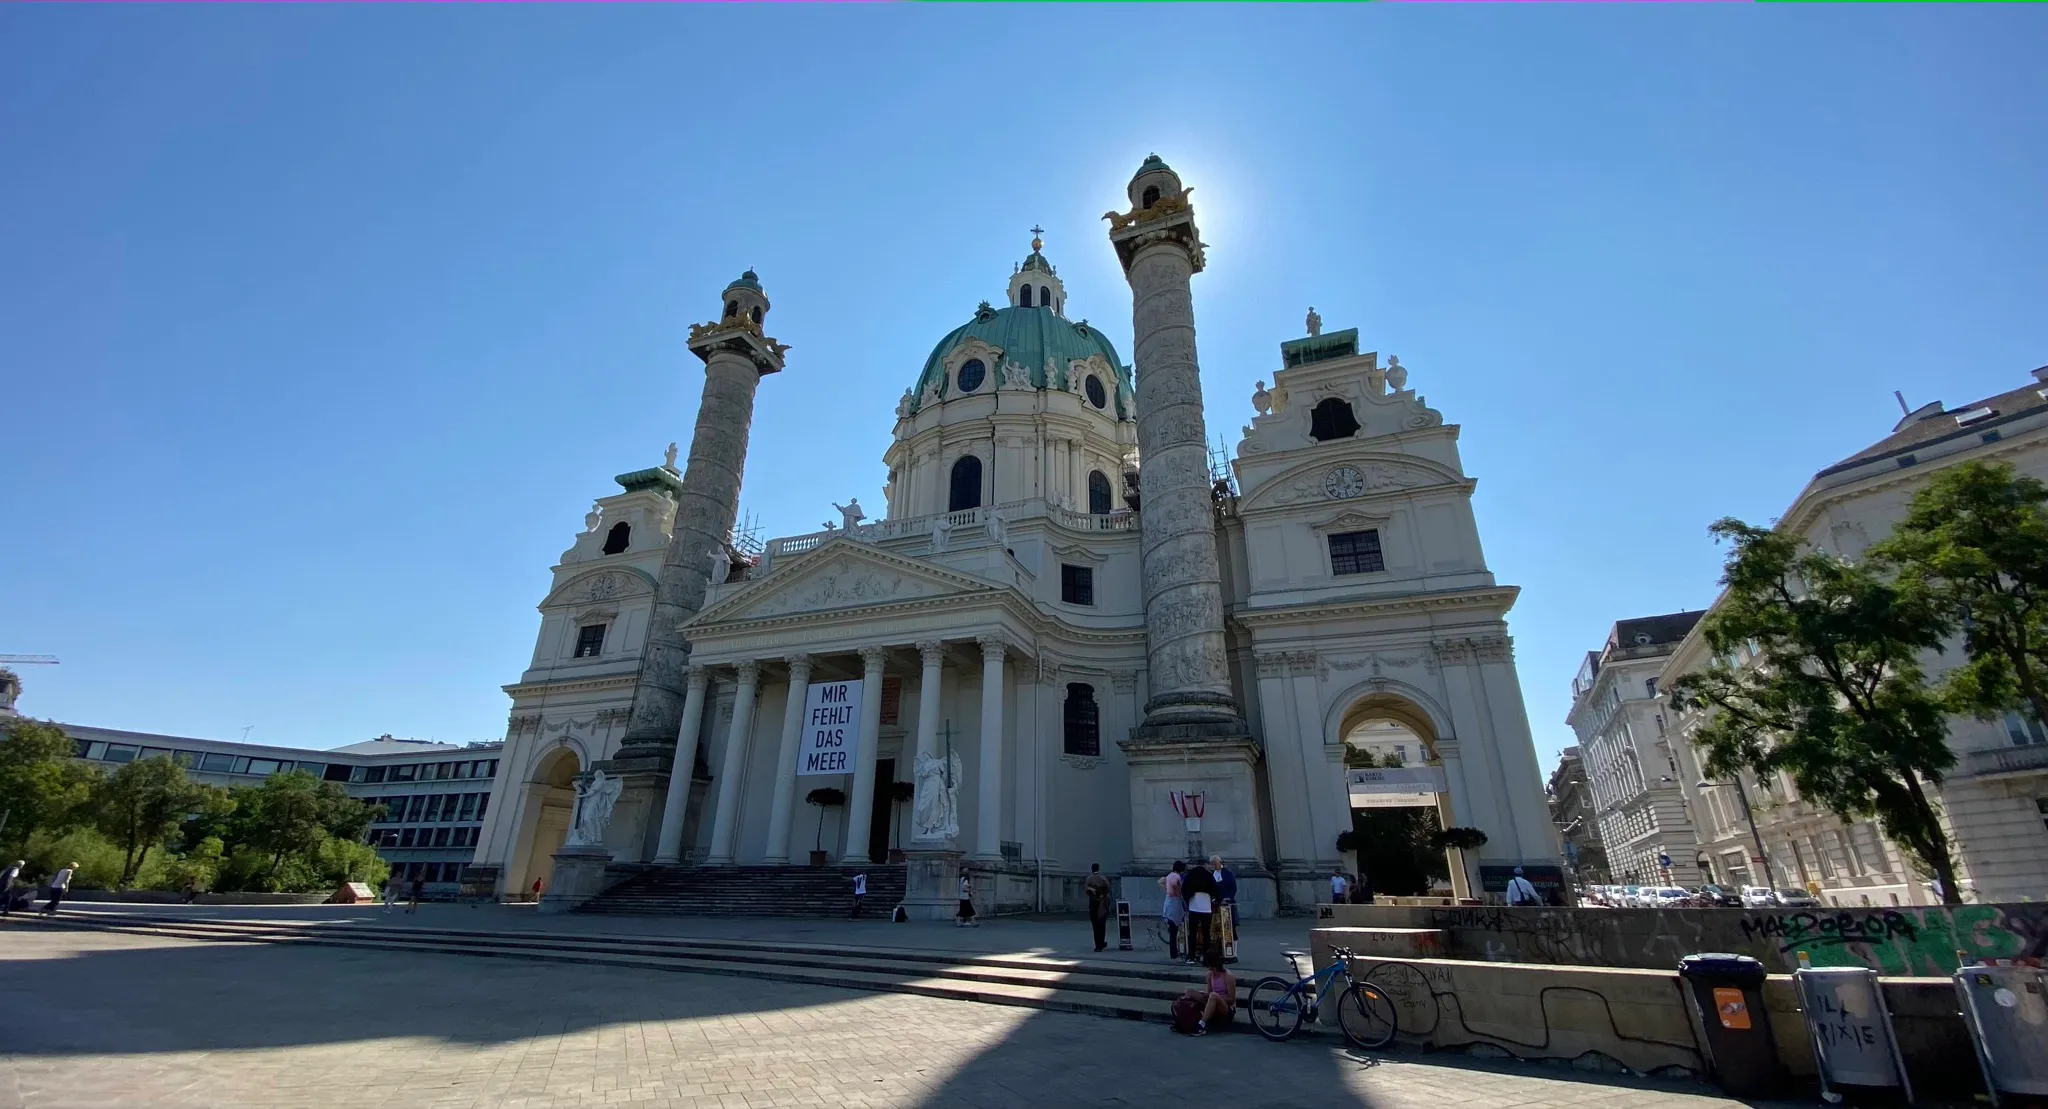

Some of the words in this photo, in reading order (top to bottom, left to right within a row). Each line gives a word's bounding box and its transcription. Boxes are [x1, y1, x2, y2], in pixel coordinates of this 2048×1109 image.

[821, 685, 848, 703] MIR
[812, 706, 853, 726] FEHLT
[815, 729, 844, 748] DAS
[806, 751, 847, 771] MEER
